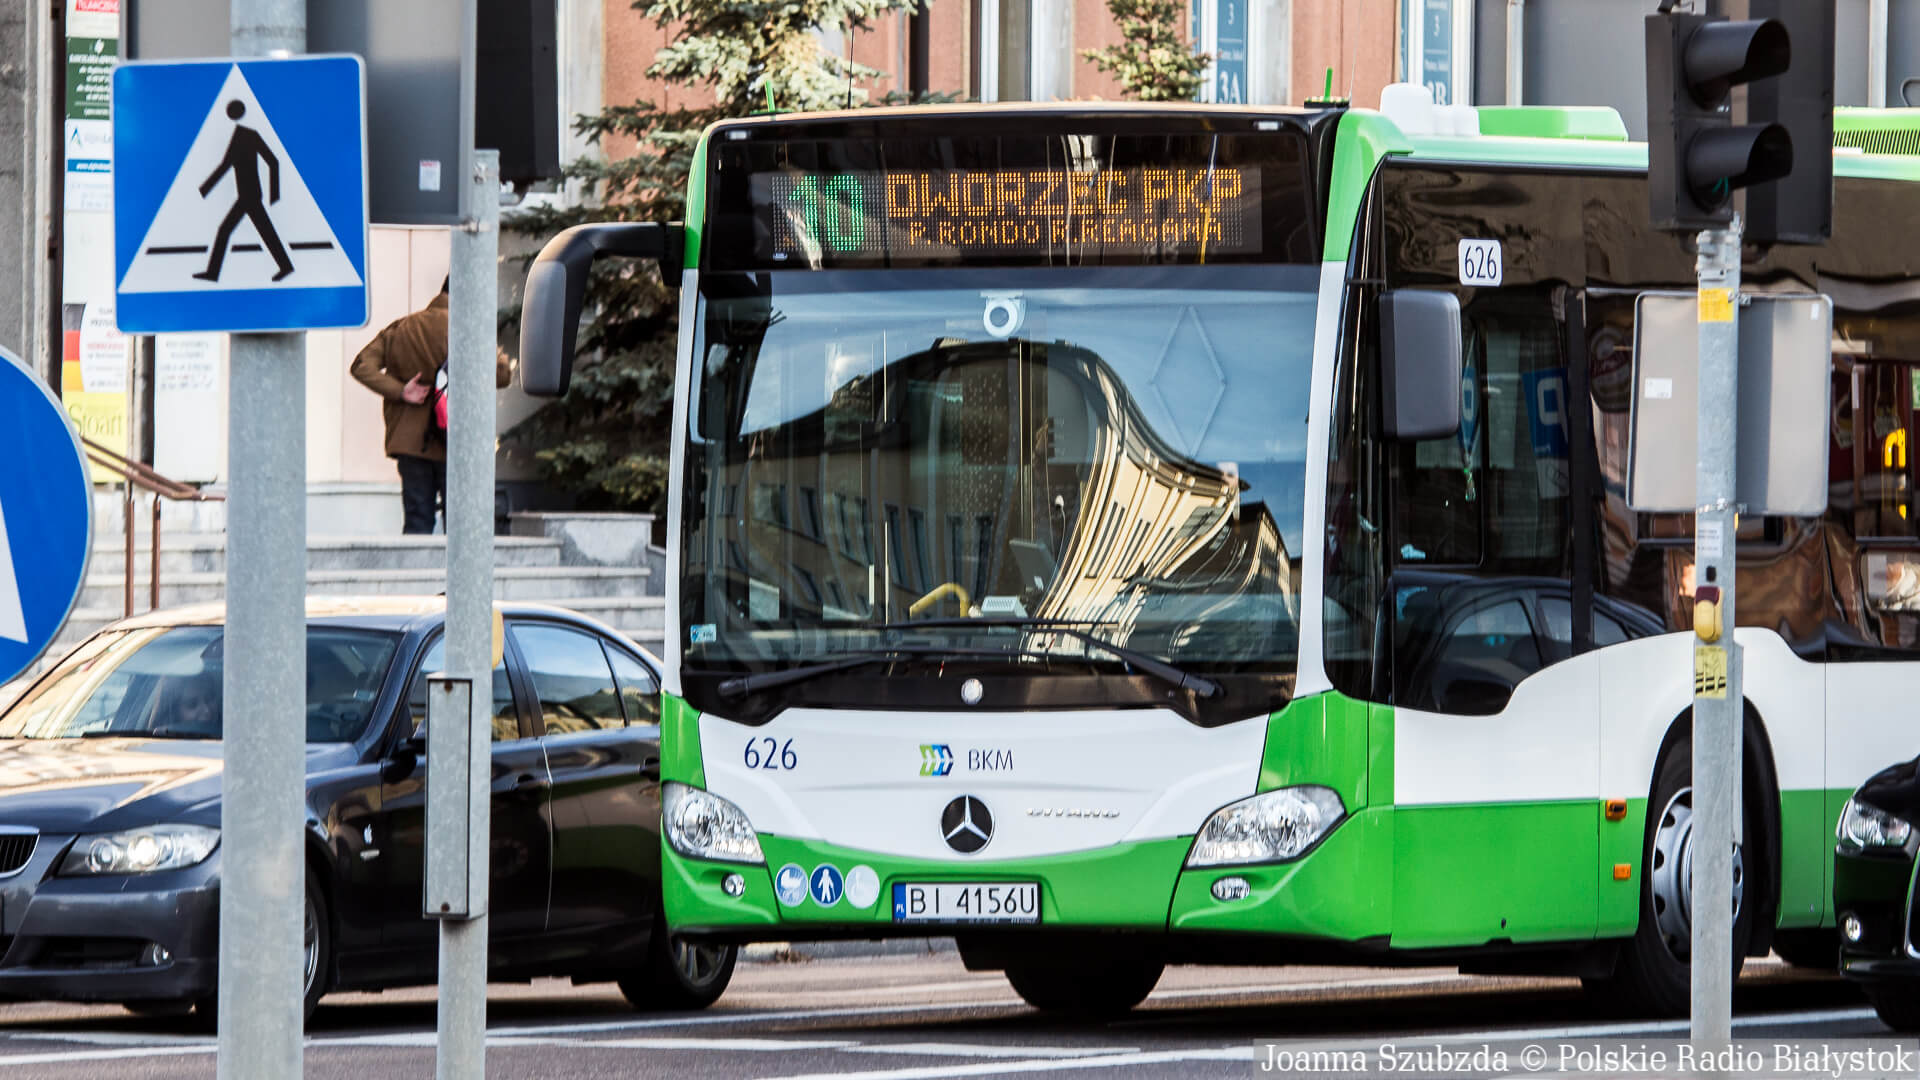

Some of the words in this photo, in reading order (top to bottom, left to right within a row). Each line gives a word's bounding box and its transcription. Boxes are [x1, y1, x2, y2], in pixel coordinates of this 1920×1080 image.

[887, 170, 1127, 217] DWORZEC
[1144, 168, 1242, 213] PKP
[788, 175, 864, 251] 10
[1464, 245, 1497, 279] 626
[744, 736, 798, 771] 626
[967, 748, 1014, 772] BKM
[956, 886, 1035, 915] 4156U
